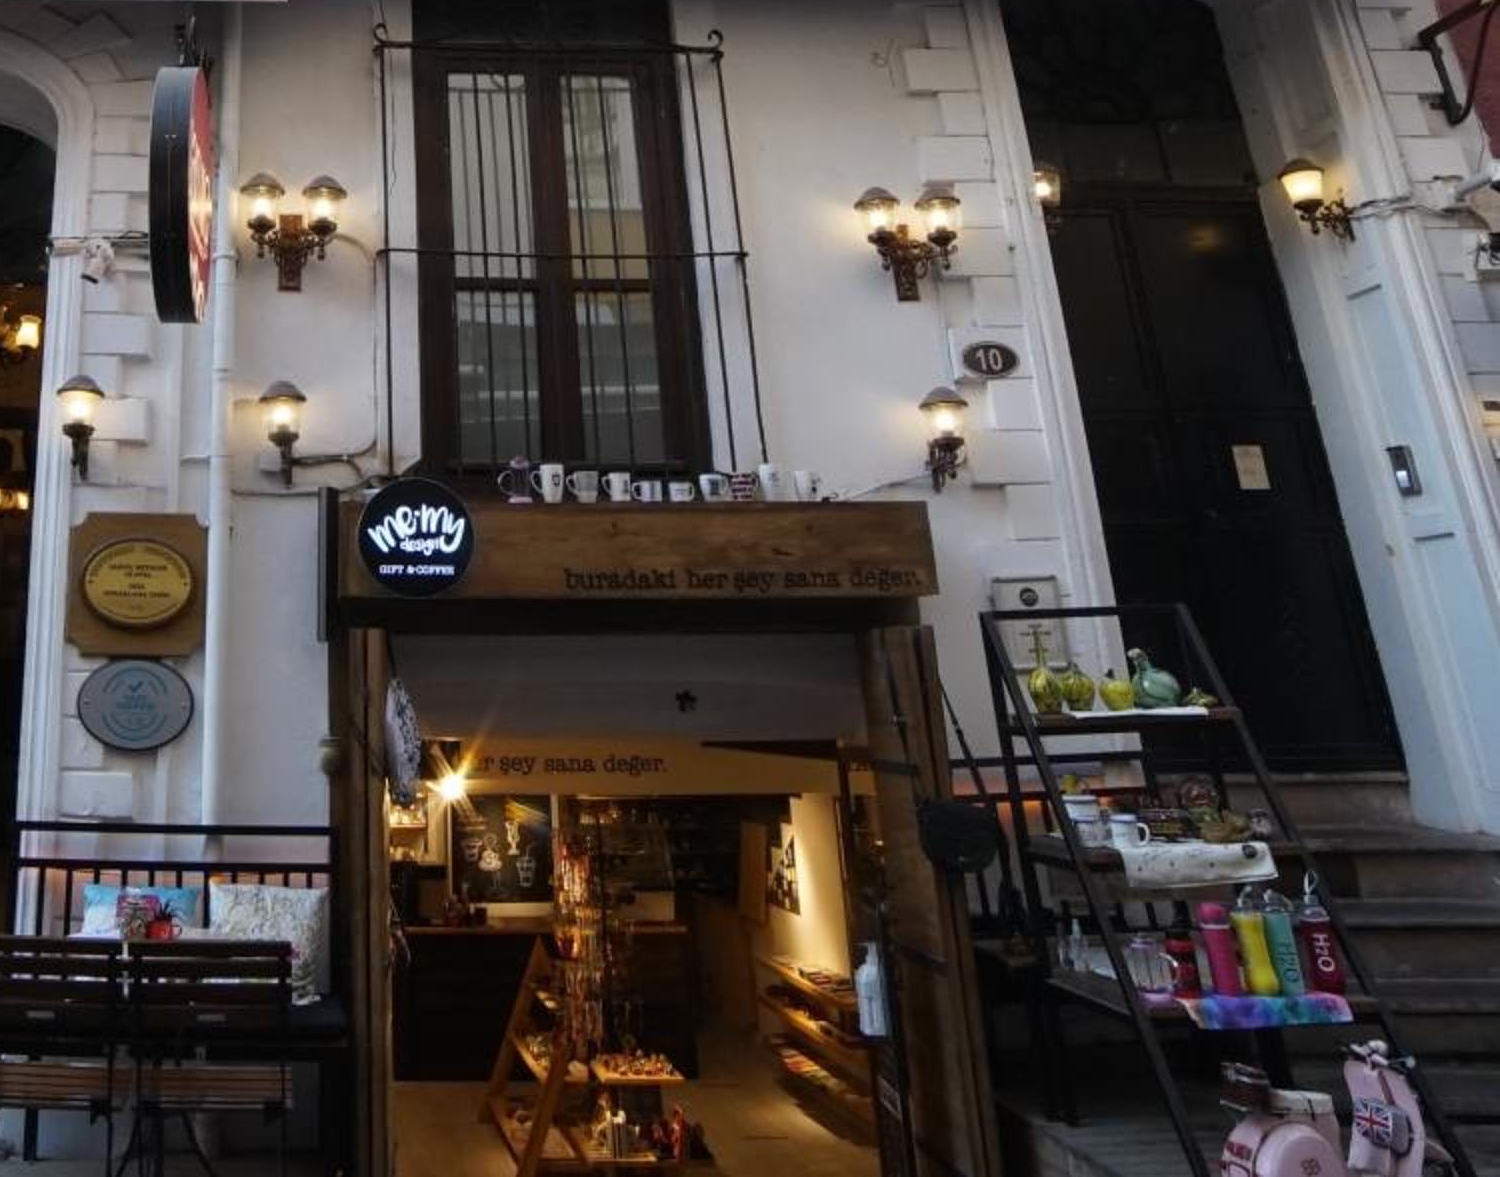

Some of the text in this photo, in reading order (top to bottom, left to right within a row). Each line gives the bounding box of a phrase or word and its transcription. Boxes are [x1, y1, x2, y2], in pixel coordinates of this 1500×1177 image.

[975, 348, 1003, 372] 10
[379, 564, 405, 574] GIFT
[415, 565, 455, 575] COFFEE
[564, 567, 677, 590] buradaki
[687, 568, 729, 589] her
[734, 571, 776, 594] şey
[784, 571, 841, 589] sana
[499, 755, 538, 775] şey
[546, 756, 597, 773] sana
